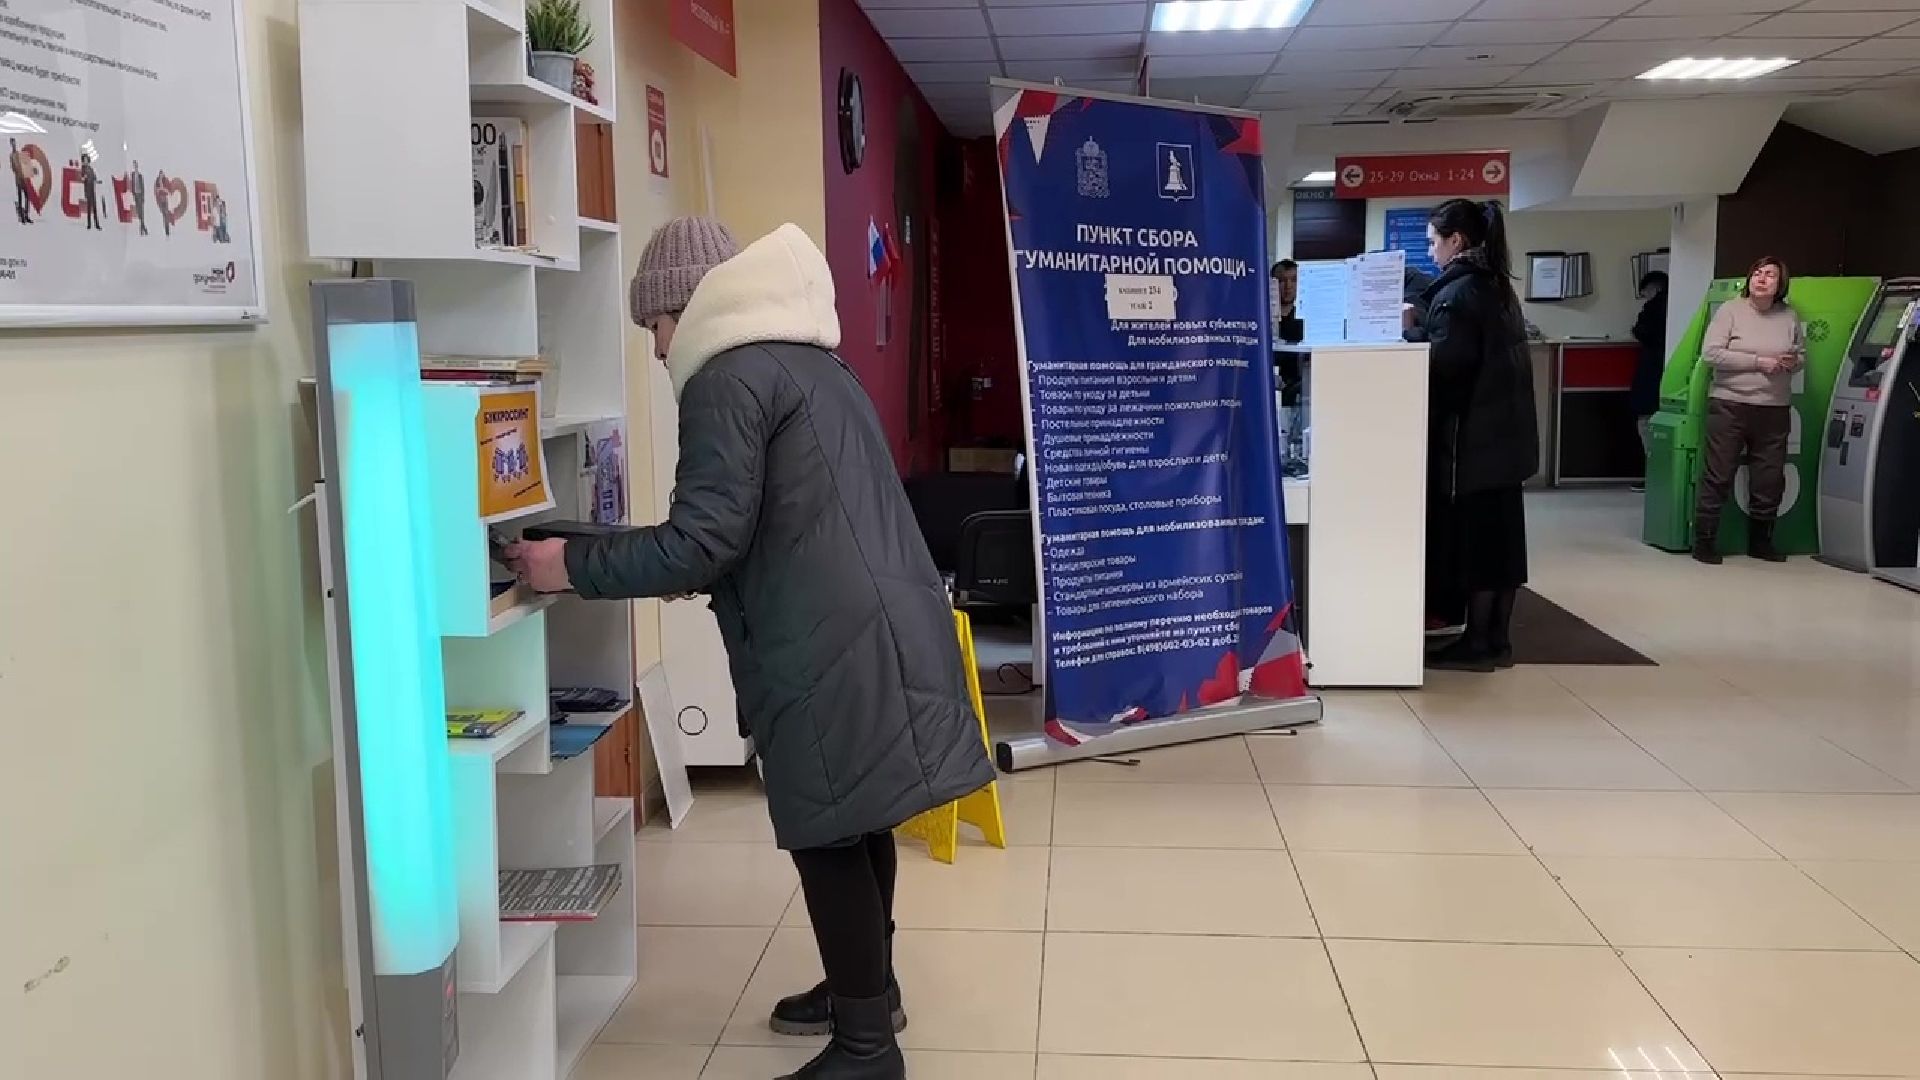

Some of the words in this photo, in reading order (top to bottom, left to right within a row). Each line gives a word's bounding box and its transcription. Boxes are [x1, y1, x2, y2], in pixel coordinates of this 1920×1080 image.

[1370, 170, 1405, 184] 25-29
[1409, 169, 1441, 181] Окна
[1449, 168, 1475, 181] 1-24
[1076, 223, 1132, 245] ПУНКТ
[1137, 227, 1198, 248] СБОРА
[1013, 249, 1159, 274] ГУМАНИТАРНОЙ
[1164, 256, 1246, 280] ПОМОЩИ
